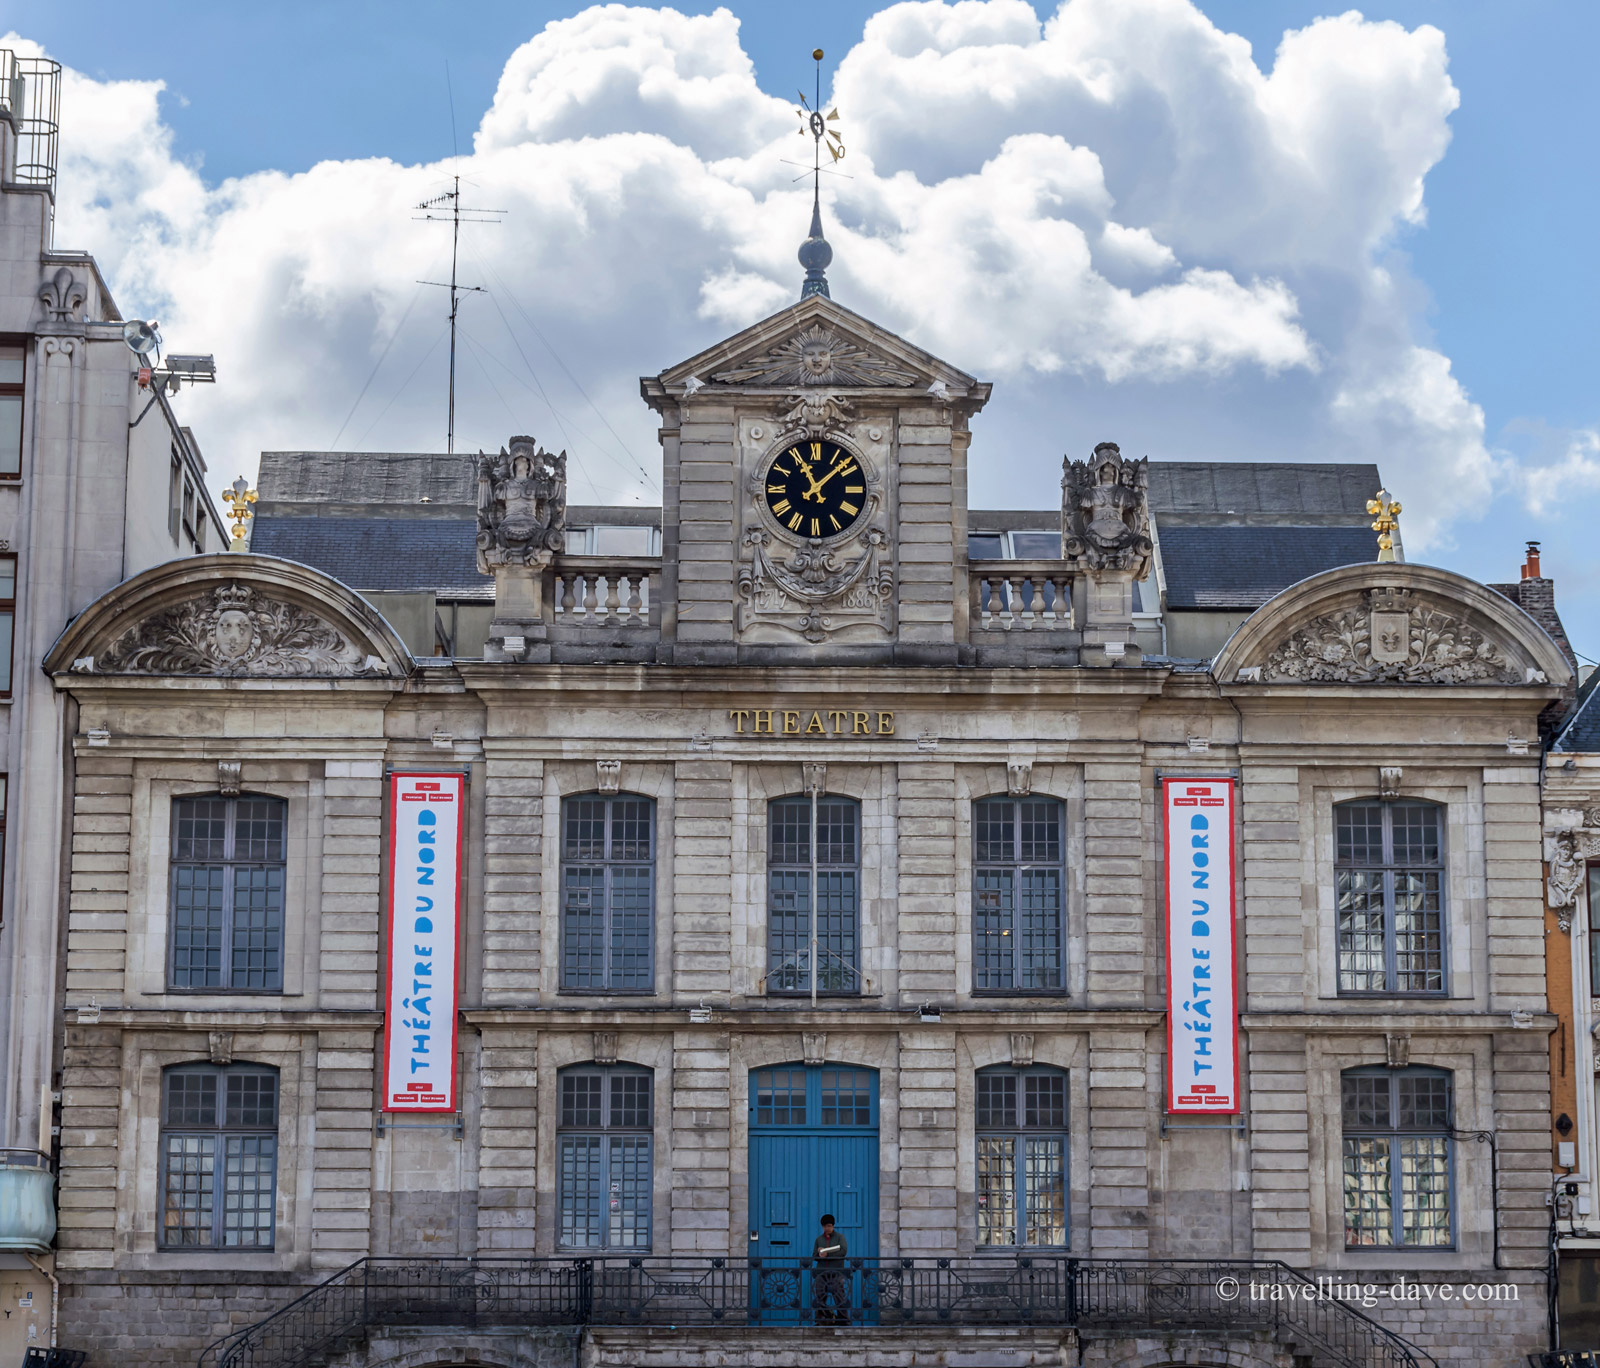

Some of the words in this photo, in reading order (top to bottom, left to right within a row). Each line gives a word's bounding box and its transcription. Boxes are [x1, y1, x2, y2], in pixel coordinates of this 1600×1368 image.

[810, 443, 821, 461] XII
[829, 449, 841, 466] I
[773, 463, 791, 478] X
[840, 464, 858, 478] II
[767, 484, 786, 494] IX
[845, 485, 863, 494] III
[772, 498, 792, 517] VIII
[839, 500, 859, 517] IIII
[787, 511, 804, 532] VII
[811, 518, 821, 536] VI
[829, 514, 842, 531] V
[841, 590, 872, 608] 1886
[729, 710, 896, 735] THEATRE
[416, 809, 437, 886] NORD
[1190, 814, 1210, 890] NORD
[414, 896, 434, 933] DU
[1191, 899, 1210, 937] DU
[402, 944, 433, 1075] THÉÂTRE
[1183, 948, 1213, 1077] THÉÂTRE
